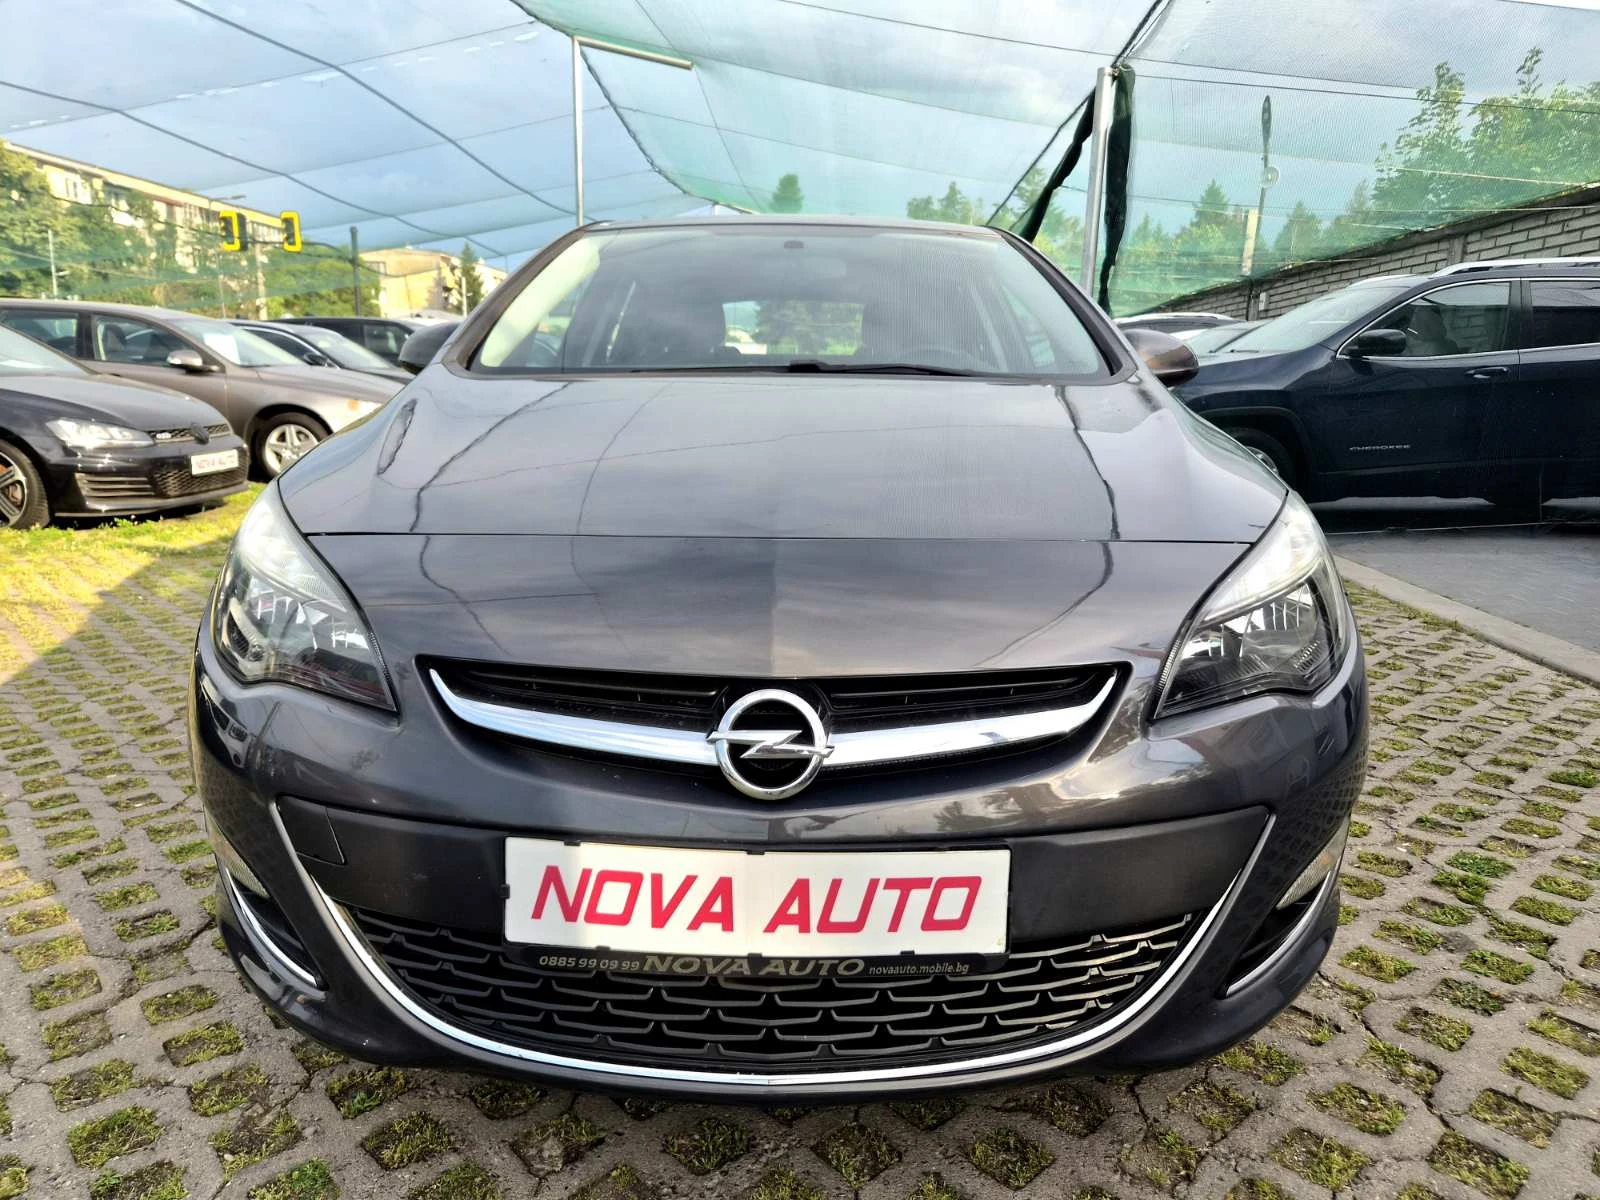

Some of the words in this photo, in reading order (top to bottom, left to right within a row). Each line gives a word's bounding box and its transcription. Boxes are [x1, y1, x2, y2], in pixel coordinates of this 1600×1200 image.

[531, 865, 734, 932] NOVA
[763, 876, 982, 933] AUTO
[539, 955, 576, 967] 0885
[578, 958, 597, 968] 99
[600, 960, 618, 970] 09
[621, 961, 640, 971] 99
[643, 955, 751, 975] NOVA
[758, 958, 865, 976] AUTO
[869, 962, 969, 976] novaauto.mobile.bg
